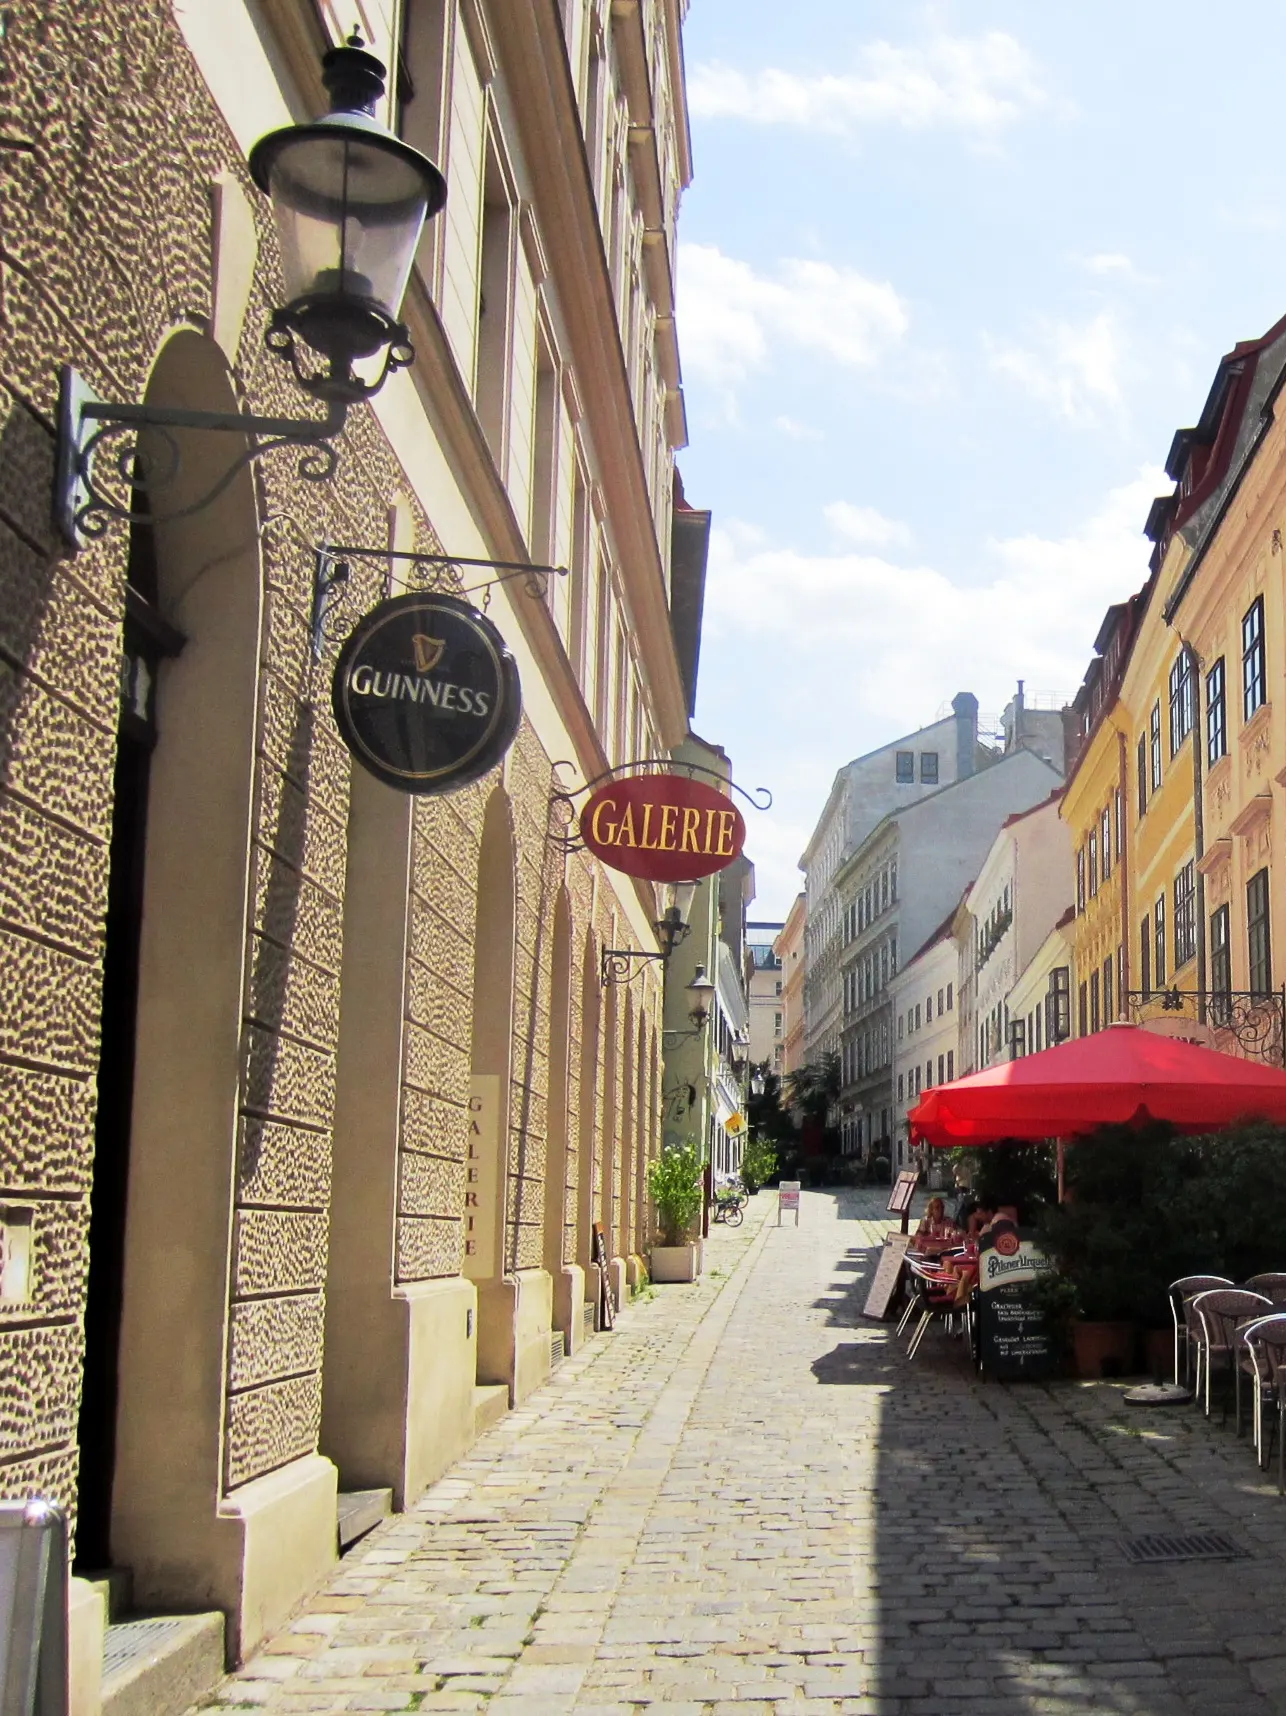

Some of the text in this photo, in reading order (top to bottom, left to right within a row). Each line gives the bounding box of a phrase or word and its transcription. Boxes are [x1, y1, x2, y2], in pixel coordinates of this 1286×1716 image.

[351, 665, 492, 717] GUINNESS
[591, 800, 736, 856] GALERIE
[465, 1096, 483, 1256] GALERIE
[988, 1255, 1019, 1279] Pilsner
